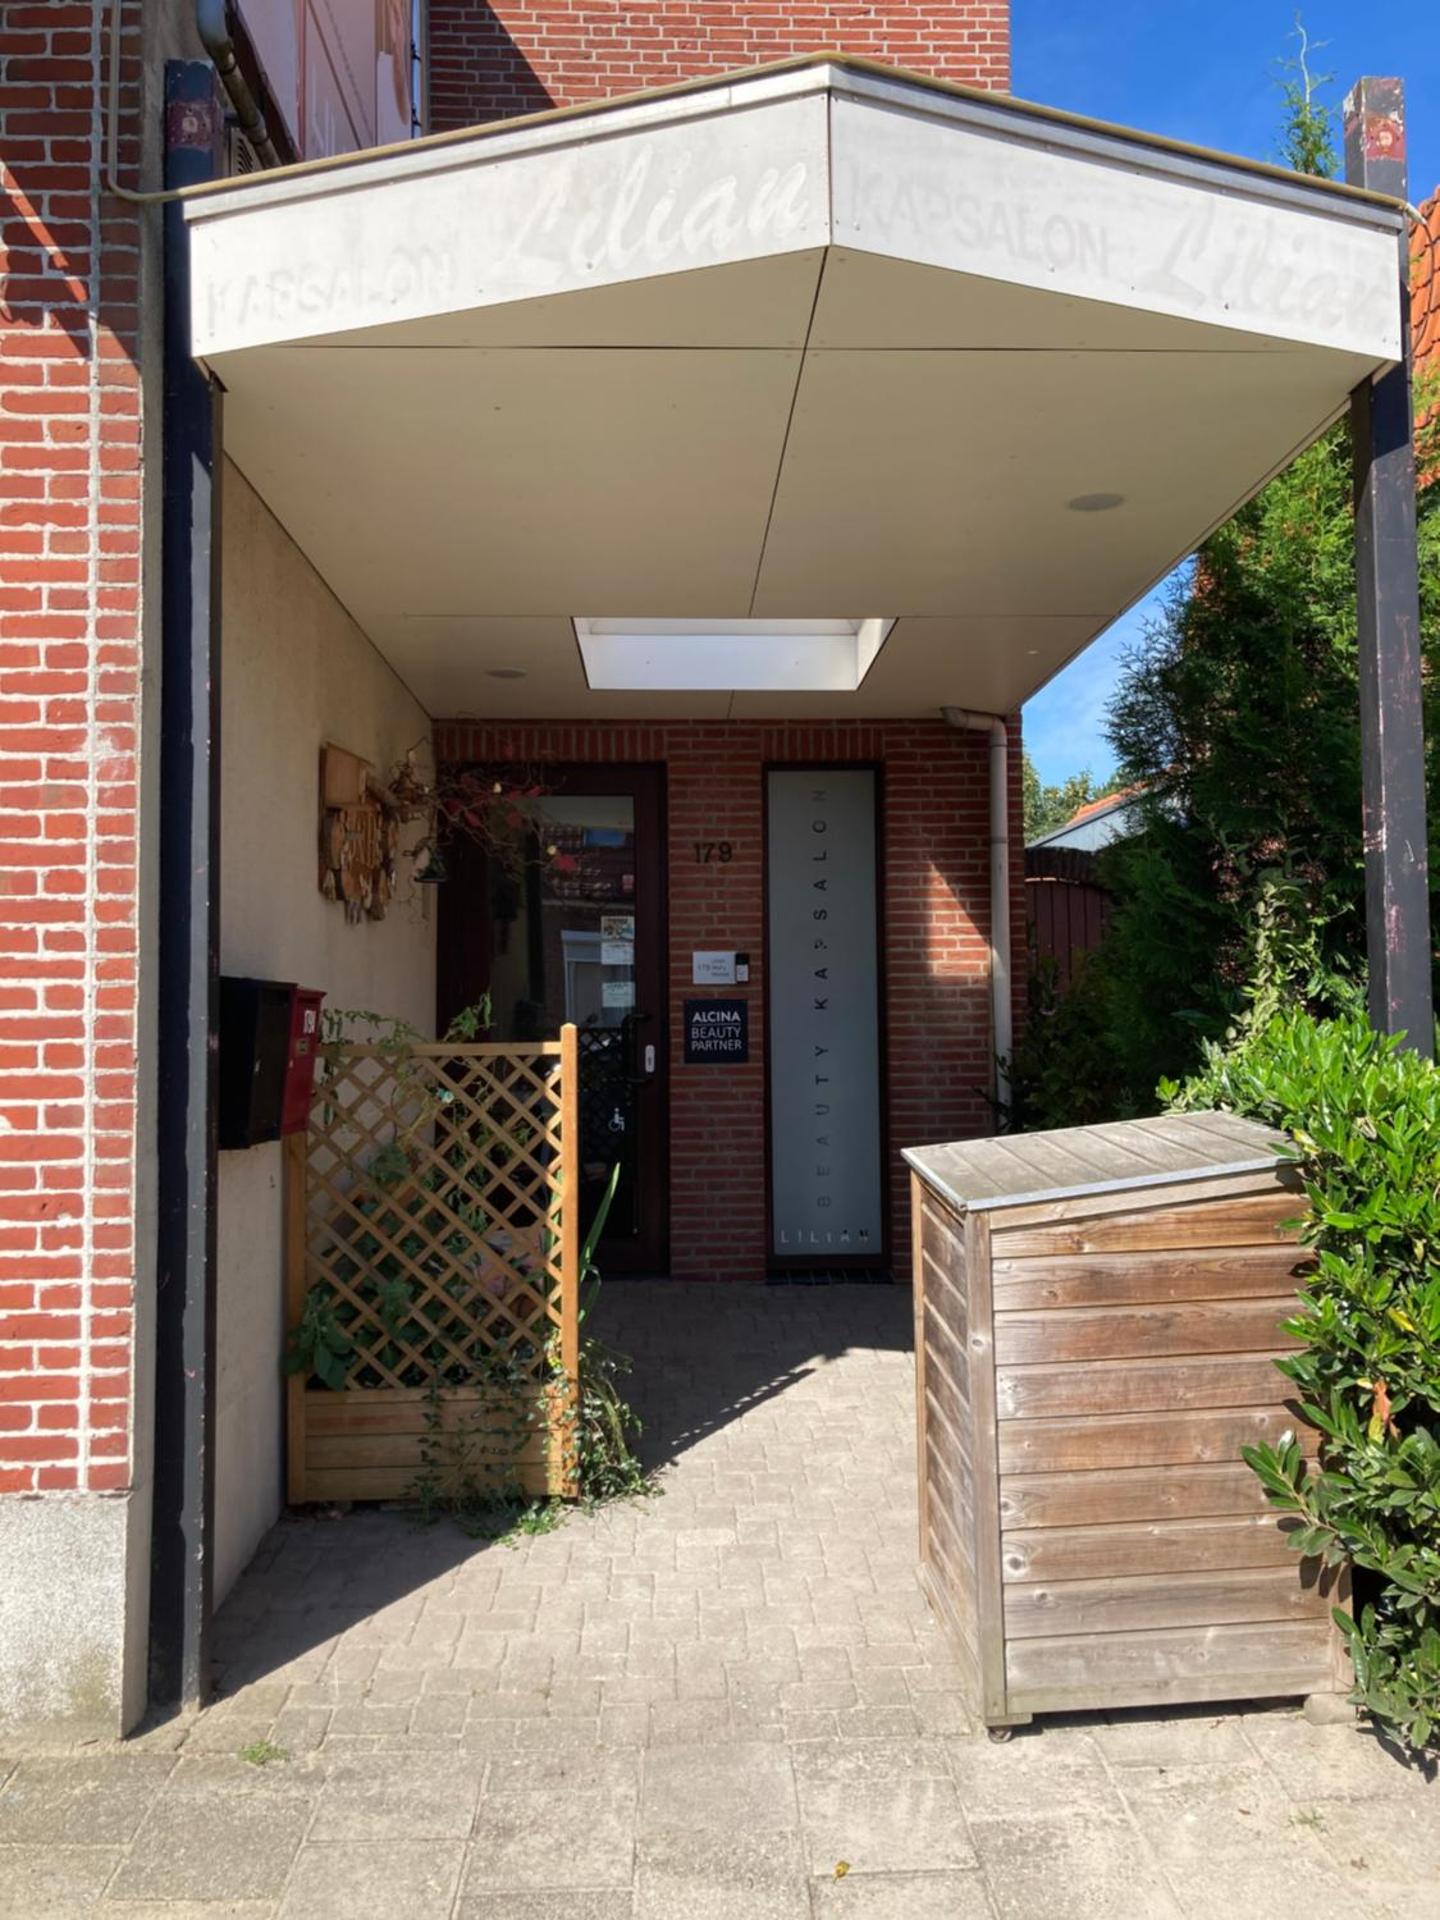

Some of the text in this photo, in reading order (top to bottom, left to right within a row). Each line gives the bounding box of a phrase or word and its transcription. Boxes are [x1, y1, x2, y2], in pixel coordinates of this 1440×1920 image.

[487, 142, 809, 286] Lilian
[850, 165, 1109, 279] KAPSALON
[693, 841, 733, 864] 179
[811, 789, 832, 1208] BEAUTY KAPSALON
[692, 1010, 741, 1023] ALCINA
[691, 1026, 741, 1039] BEAUTY
[691, 1039, 742, 1051] PARTNER
